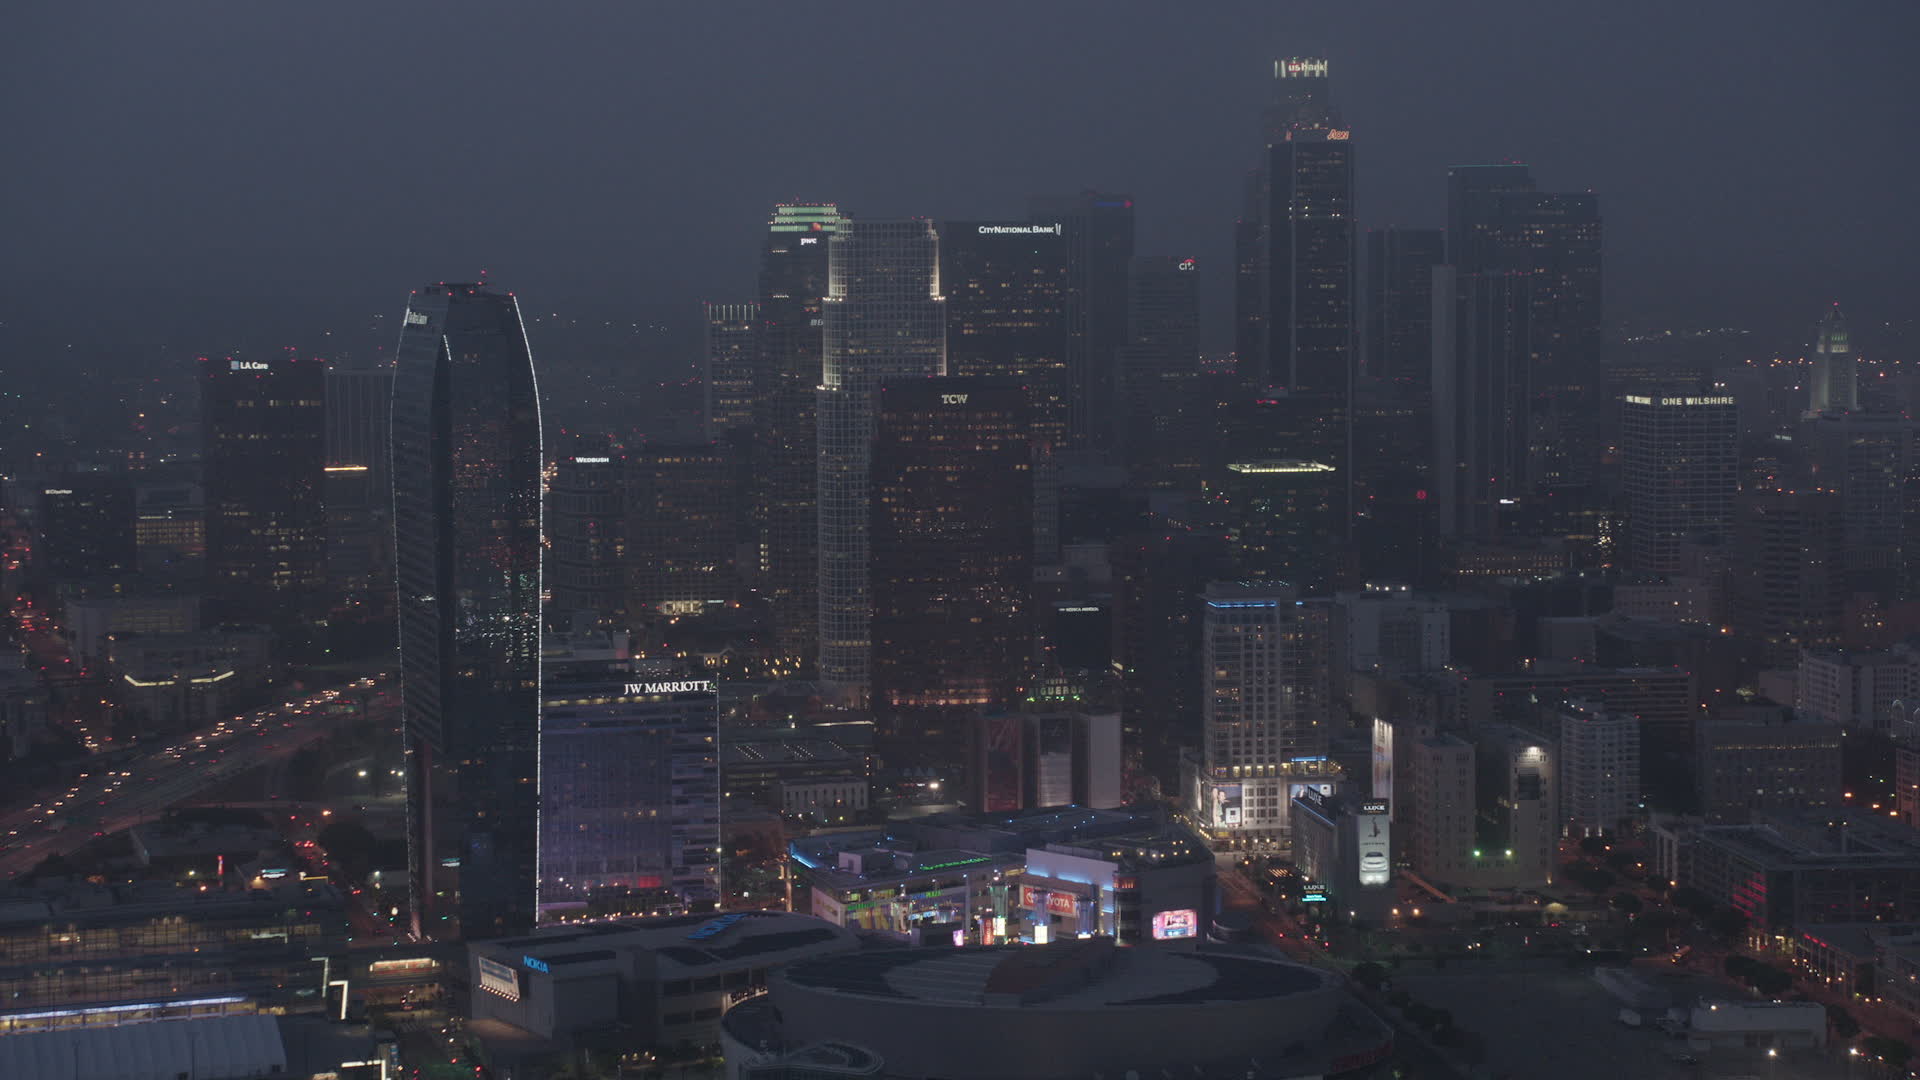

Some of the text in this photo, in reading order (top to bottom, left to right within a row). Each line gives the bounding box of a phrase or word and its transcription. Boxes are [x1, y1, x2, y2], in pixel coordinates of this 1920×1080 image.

[240, 361, 269, 370] LA Care
[941, 394, 968, 404] TCW
[1661, 397, 1682, 406] ONE
[1685, 396, 1734, 406] WILSHIRE
[624, 680, 710, 695] JW MARRIOTT
[523, 955, 551, 974] NOKIA
